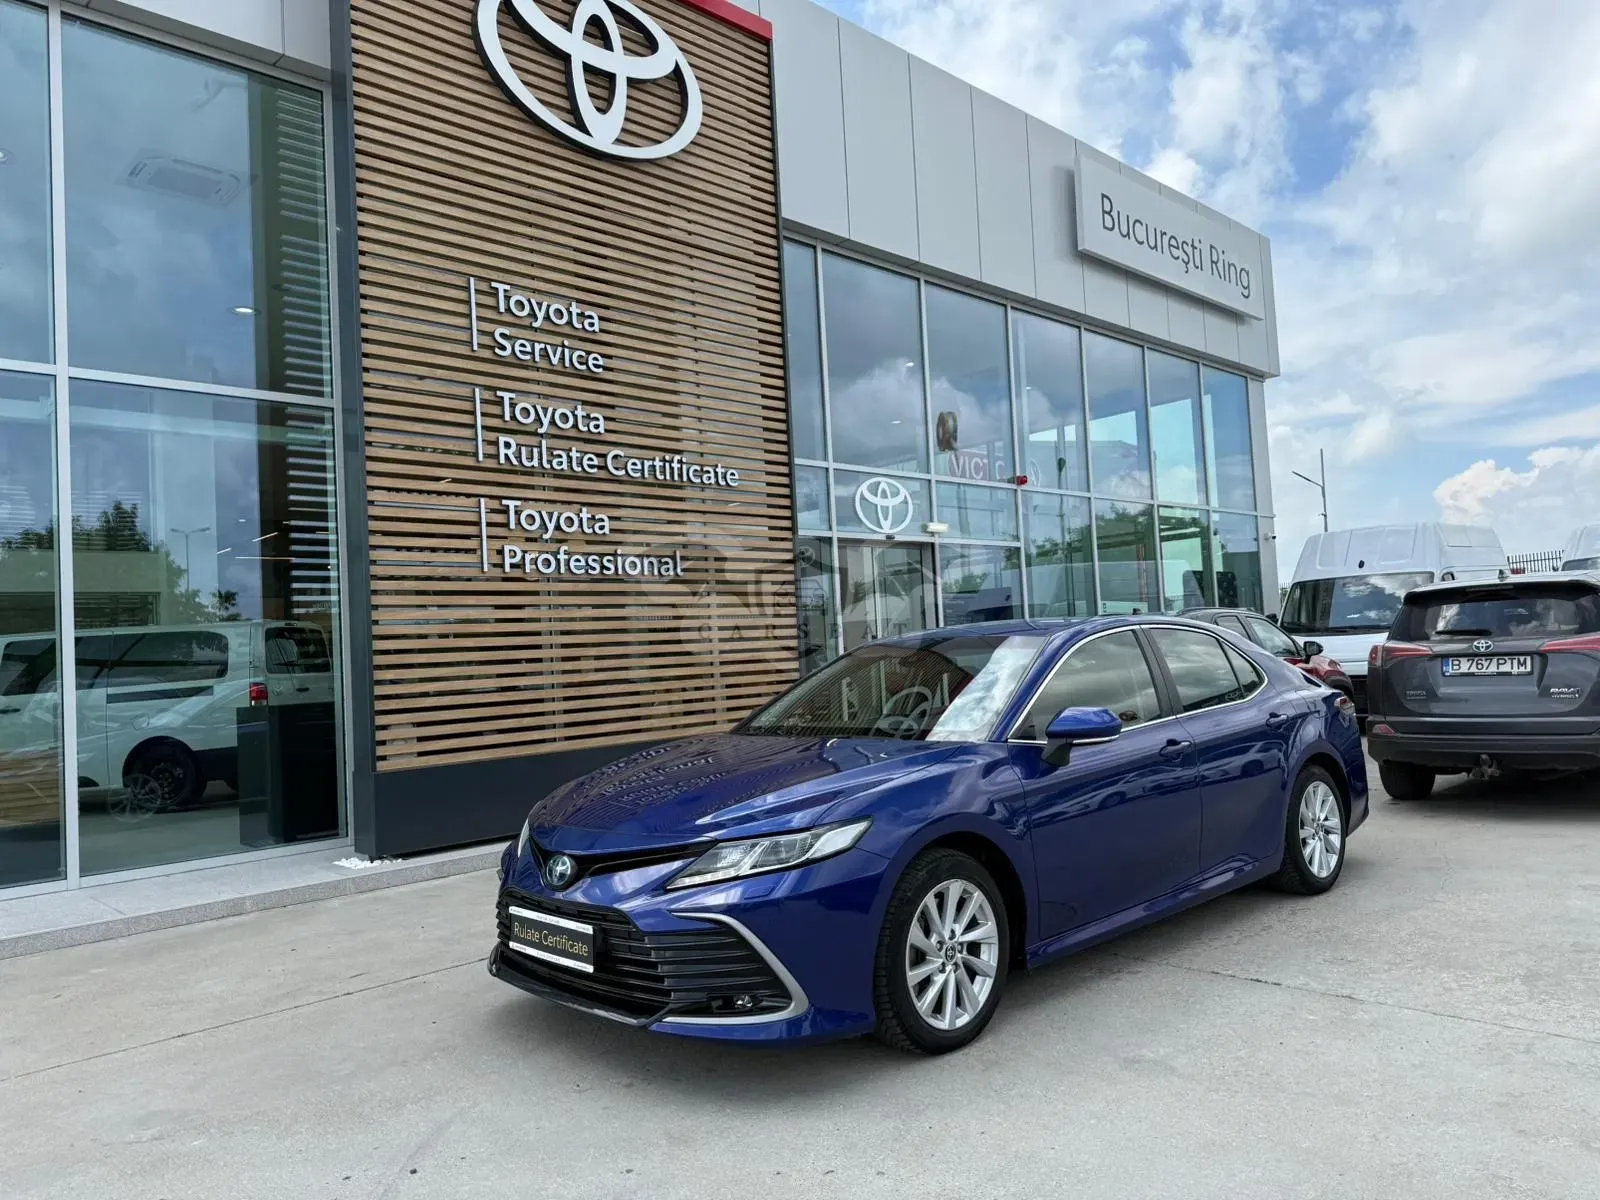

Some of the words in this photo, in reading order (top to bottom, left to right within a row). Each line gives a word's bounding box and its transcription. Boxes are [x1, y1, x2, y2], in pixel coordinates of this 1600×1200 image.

[1209, 243, 1250, 299] Ring
[491, 282, 600, 332] Toyota
[494, 328, 604, 372] Service
[496, 391, 606, 434] Toyota
[498, 436, 599, 474] Rulate
[606, 449, 740, 487] Certificate
[501, 499, 611, 539] Toyota
[503, 545, 684, 577] Professional
[1451, 659, 1462, 672] B
[1466, 658, 1492, 671] 767
[1496, 657, 1528, 671] PTM
[514, 922, 540, 943] Rulate
[541, 931, 588, 956] Certificate
